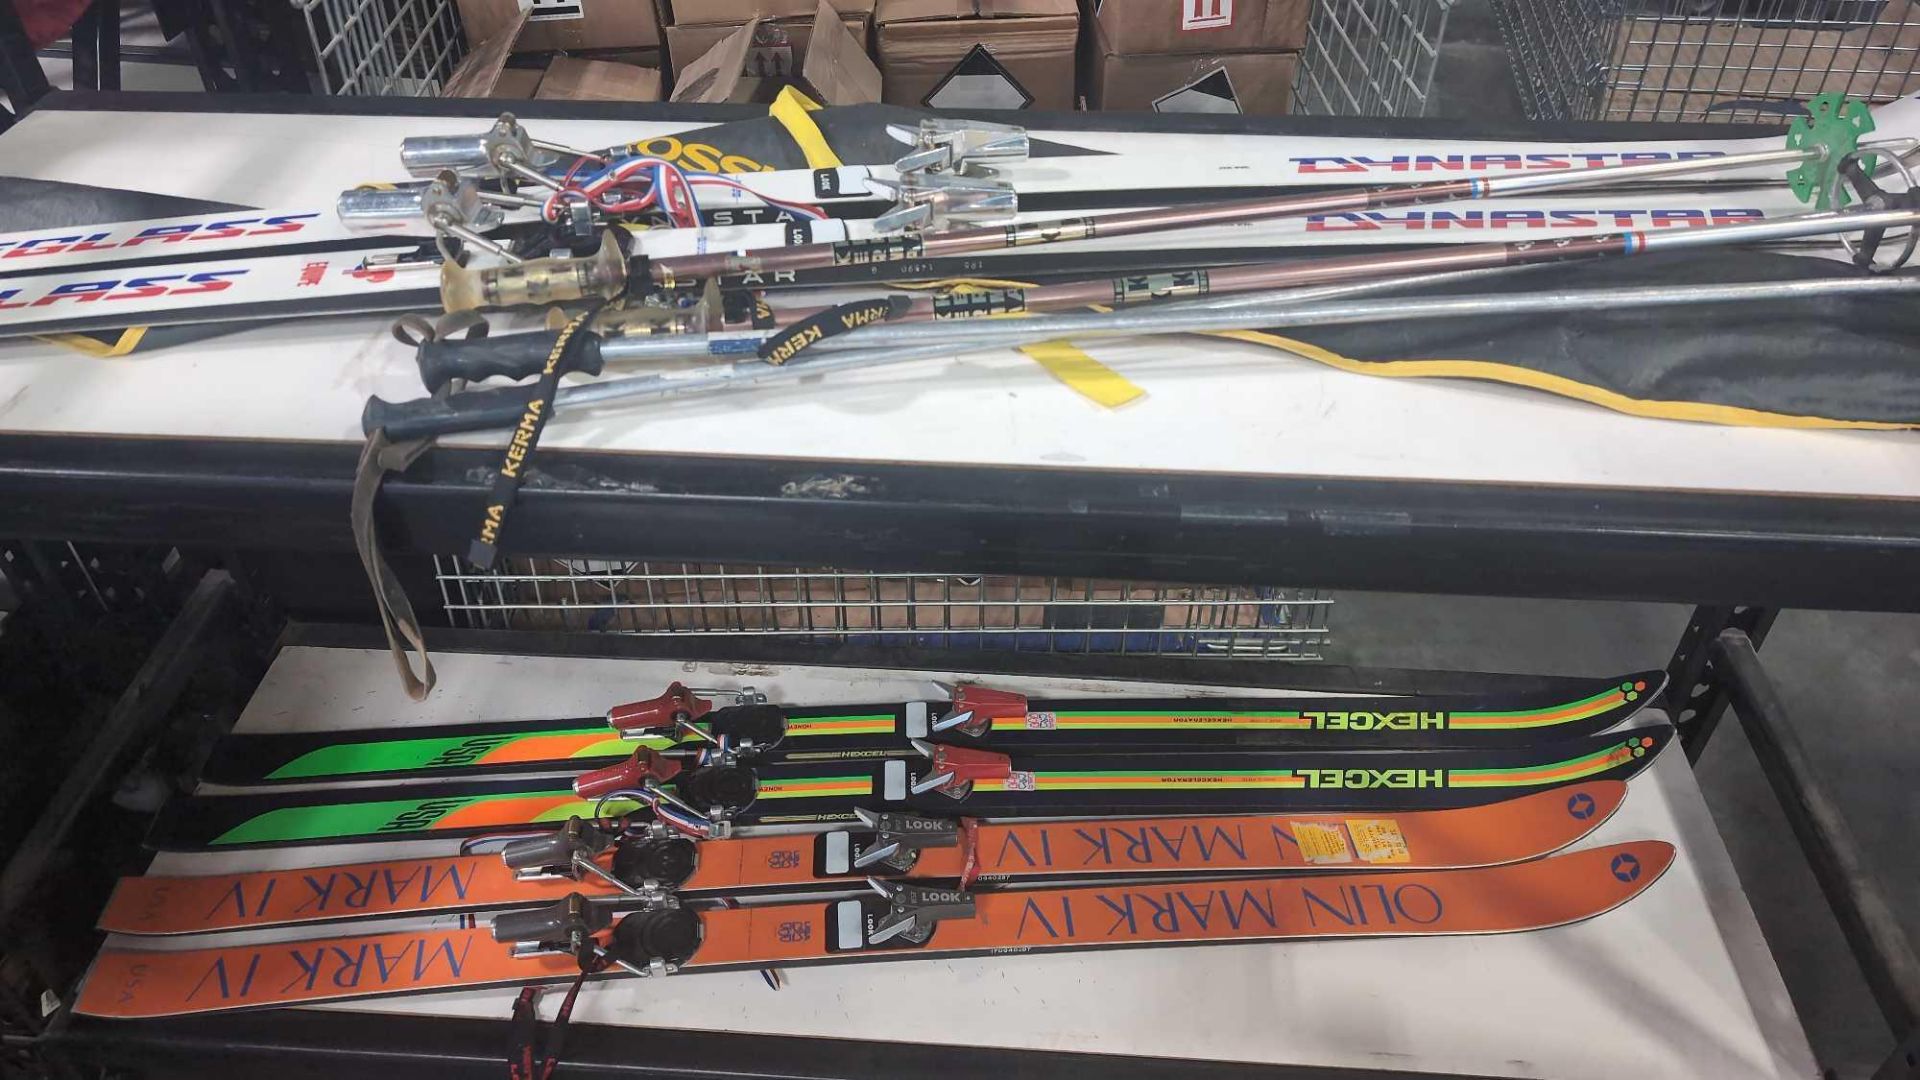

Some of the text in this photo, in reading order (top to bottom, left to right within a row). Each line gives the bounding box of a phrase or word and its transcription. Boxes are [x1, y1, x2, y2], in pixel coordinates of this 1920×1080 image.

[634, 136, 776, 174] OSS
[0, 213, 320, 259] GLASS
[1306, 209, 1765, 232] DYNASTAR
[767, 325, 823, 366] KERM
[501, 399, 545, 478] KERMA
[1303, 712, 1444, 731] HEXCEL
[426, 735, 518, 767] USA
[1296, 769, 1444, 789] HEXCEL
[376, 798, 475, 832] USA
[817, 813, 859, 821] HEXCE
[905, 820, 944, 830] LOOK
[996, 828, 1053, 867] IV
[1074, 824, 1248, 865] MARK
[206, 862, 477, 921] MARK IV
[921, 892, 961, 902] LOOK
[867, 913, 875, 936] LOOK
[1017, 883, 1443, 940] OLIN MARK IV
[185, 935, 472, 1002] MARK IV
